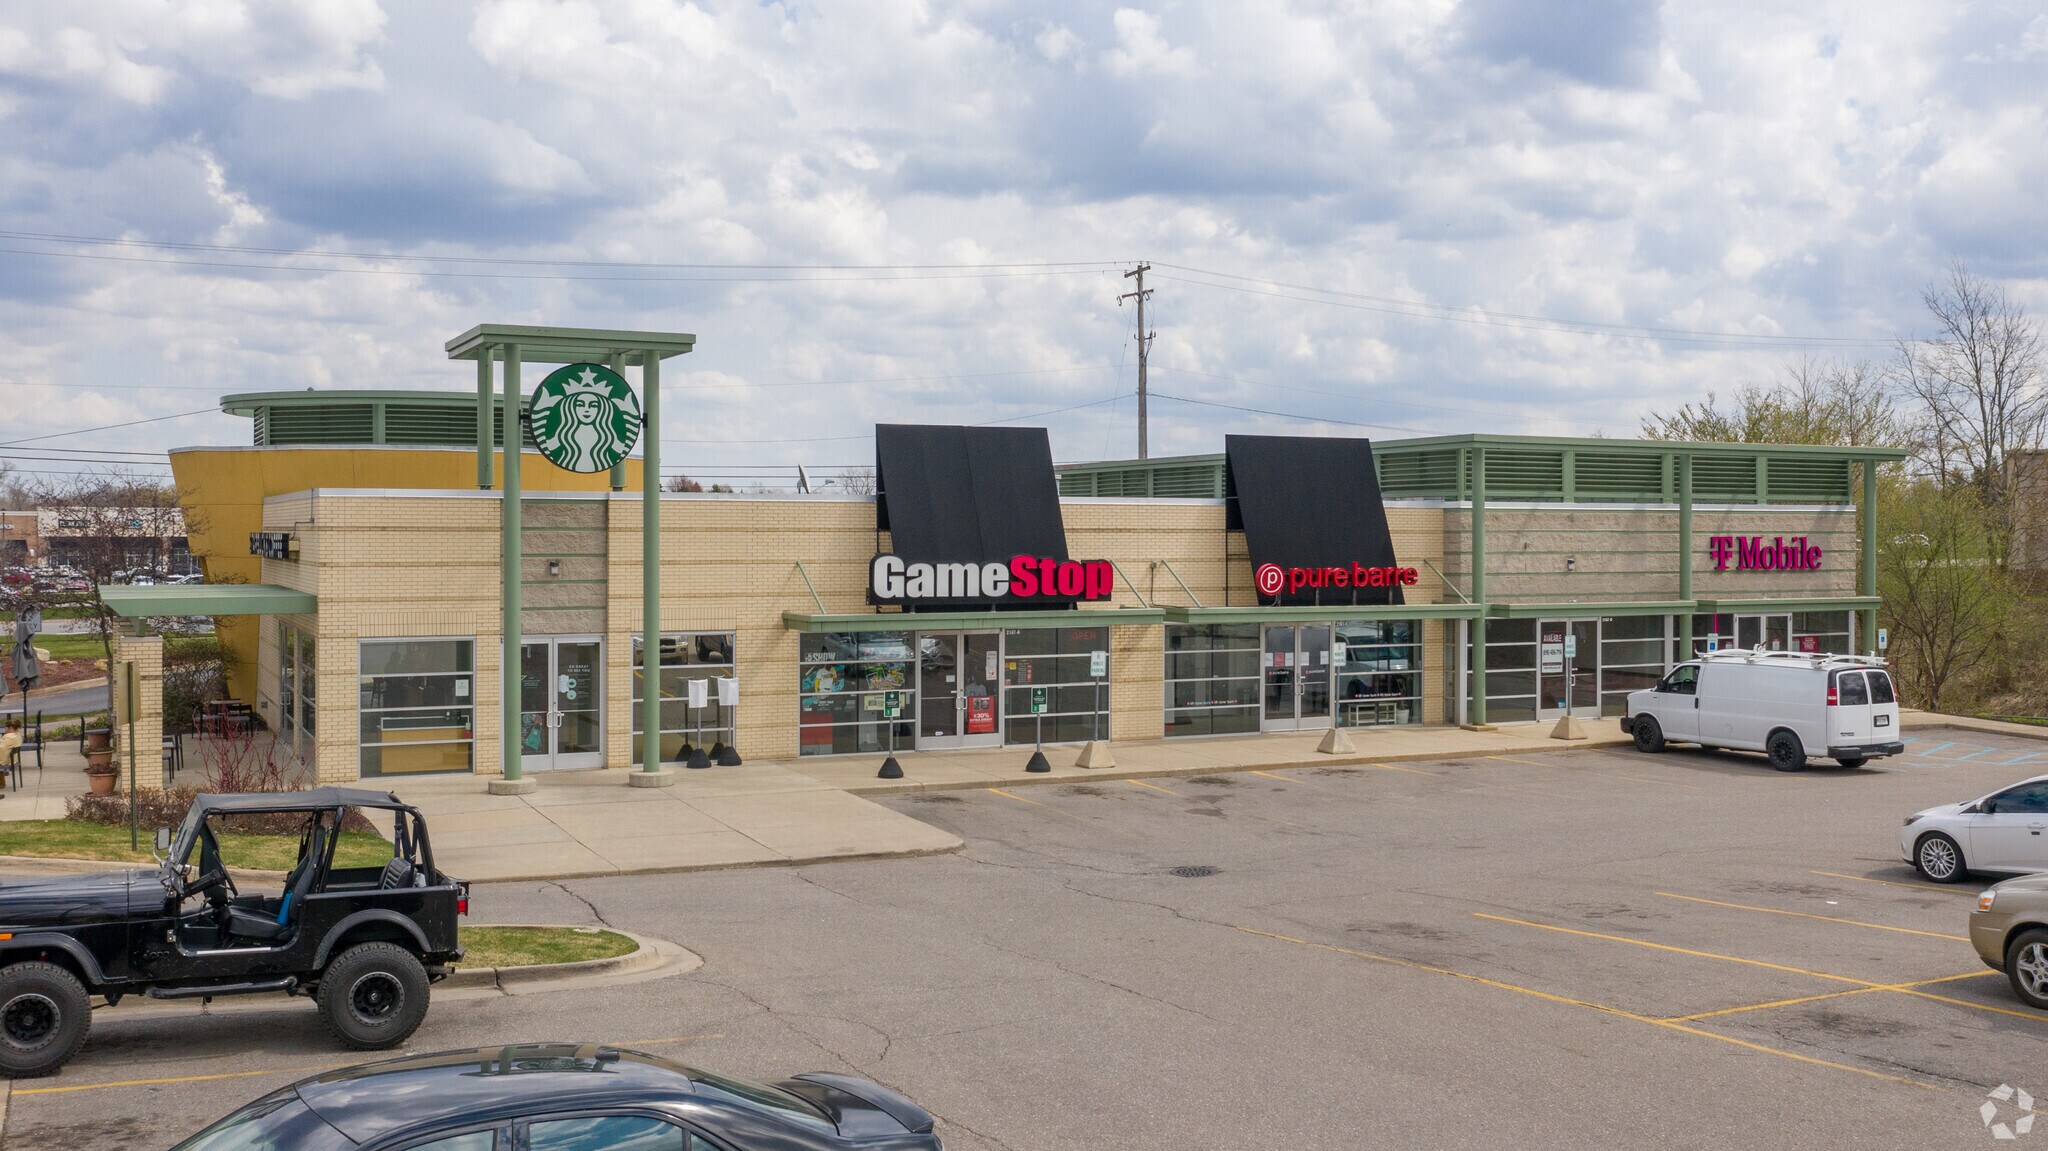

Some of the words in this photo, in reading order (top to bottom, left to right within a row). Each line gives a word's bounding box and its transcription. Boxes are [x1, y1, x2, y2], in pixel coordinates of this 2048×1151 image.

[1736, 536, 1822, 570] Mobile
[874, 555, 1114, 599] GameStop
[1289, 567, 1349, 594] pure
[1352, 561, 1418, 587] barre
